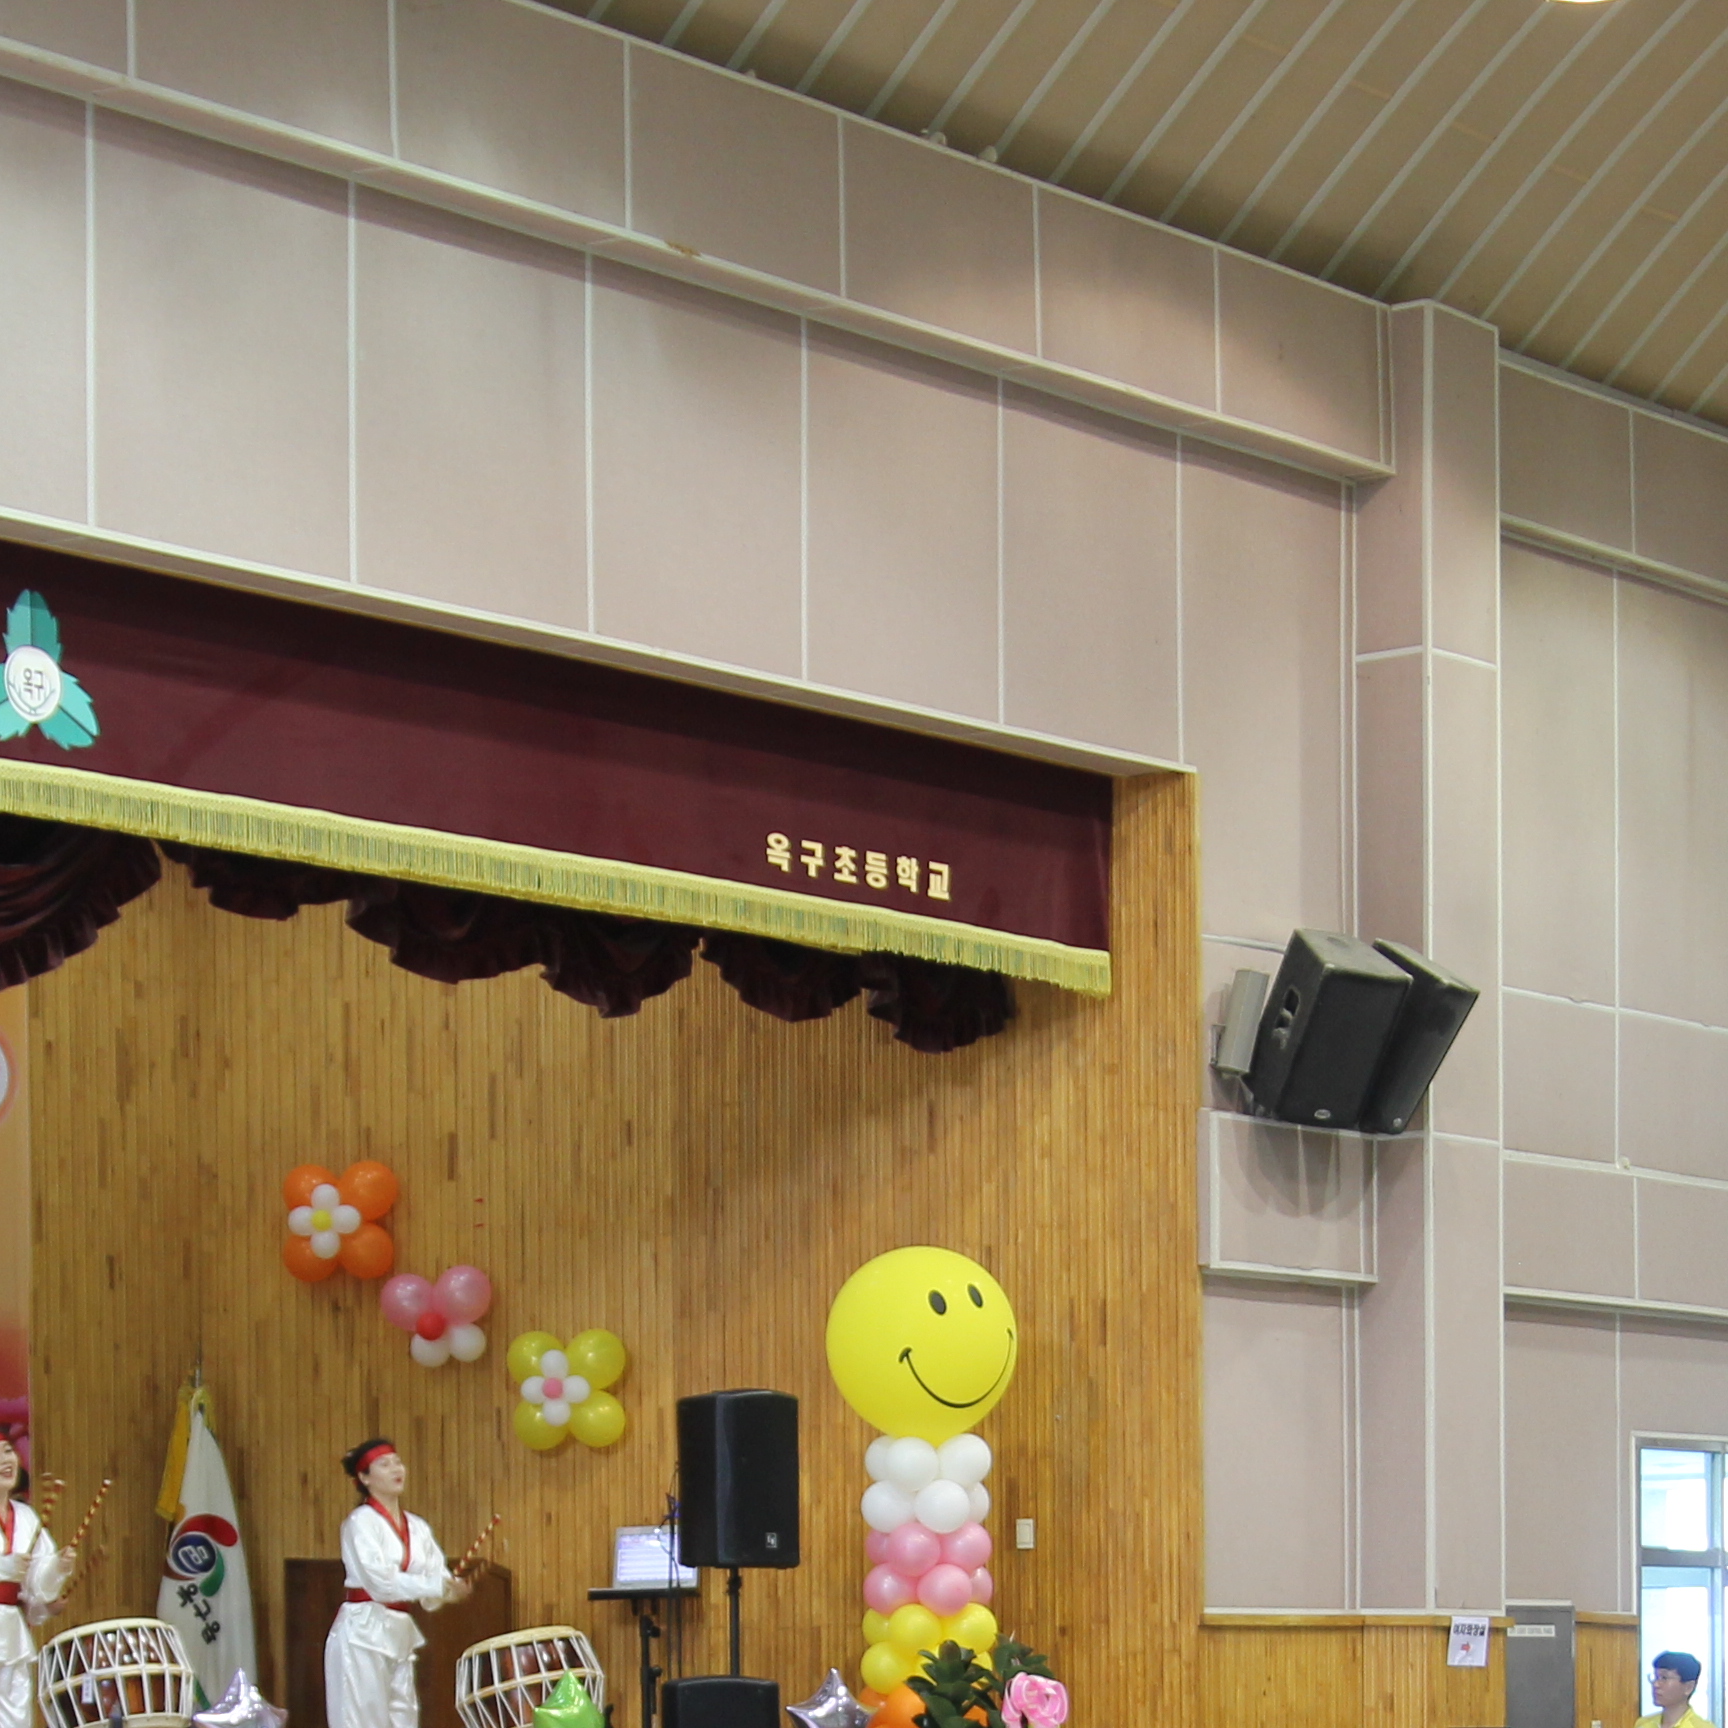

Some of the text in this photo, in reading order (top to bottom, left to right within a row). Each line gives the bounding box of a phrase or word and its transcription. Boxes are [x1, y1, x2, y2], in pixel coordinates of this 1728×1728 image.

[765, 832, 952, 901] 옥구초등학교
[176, 1582, 221, 1645] 옥구읍
[1453, 1623, 1486, 1637] 여자화장실
